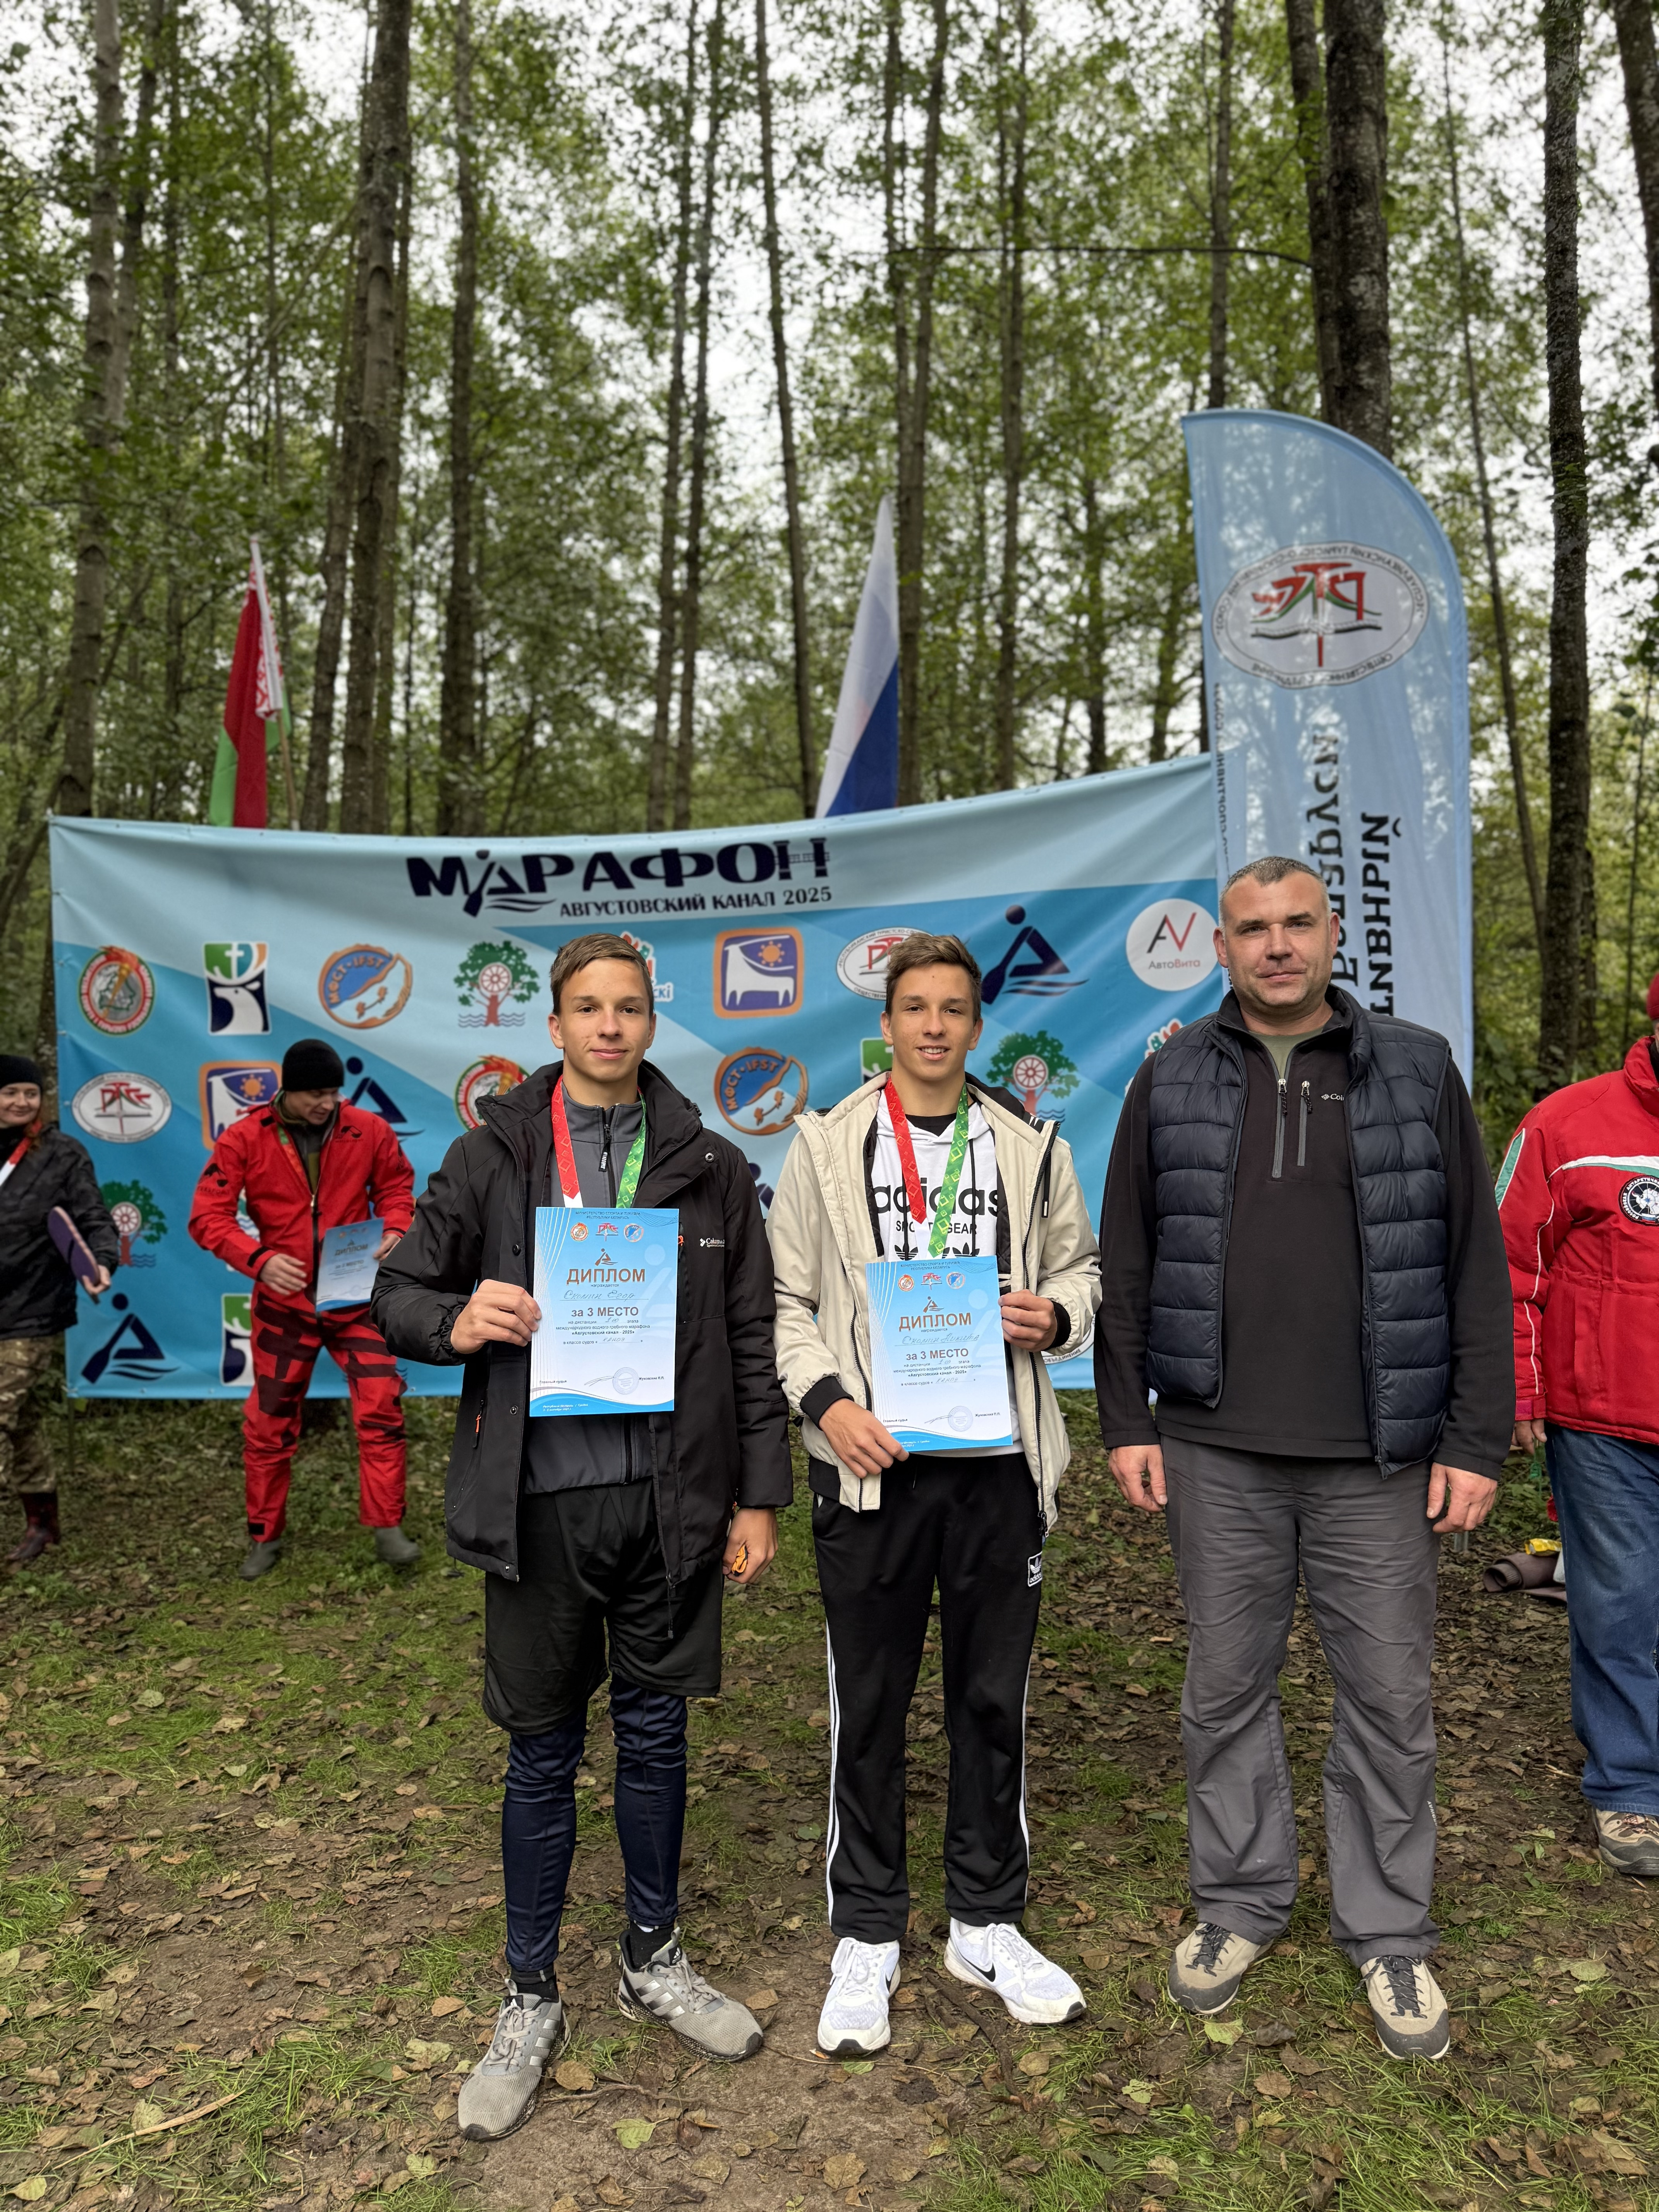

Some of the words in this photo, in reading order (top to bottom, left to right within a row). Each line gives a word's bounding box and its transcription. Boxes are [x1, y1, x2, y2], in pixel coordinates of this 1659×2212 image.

[406, 838, 830, 916] МАРАФОН
[560, 893, 706, 917] АВГУСТОВСКИЙ
[713, 891, 776, 910] КАНАЛ
[783, 886, 832, 906] 2025
[1149, 958, 1200, 970] АвтоВита
[854, 987, 887, 998] ОБЩЕСТВЕНН
[745, 1059, 778, 1072] IFST
[1626, 1177, 1659, 1190] АНТАРКТИЧЕС
[335, 1243, 368, 1256] ДИПЛОМ
[566, 1268, 646, 1286] ДИПЛОМ
[607, 1290, 635, 1302] Егор
[587, 1307, 593, 1316] 3
[598, 1307, 639, 1316] МЕСТО
[899, 1312, 972, 1332] ДИПЛОМ
[920, 1351, 926, 1360] 3
[930, 1348, 969, 1359] МЕСТО
